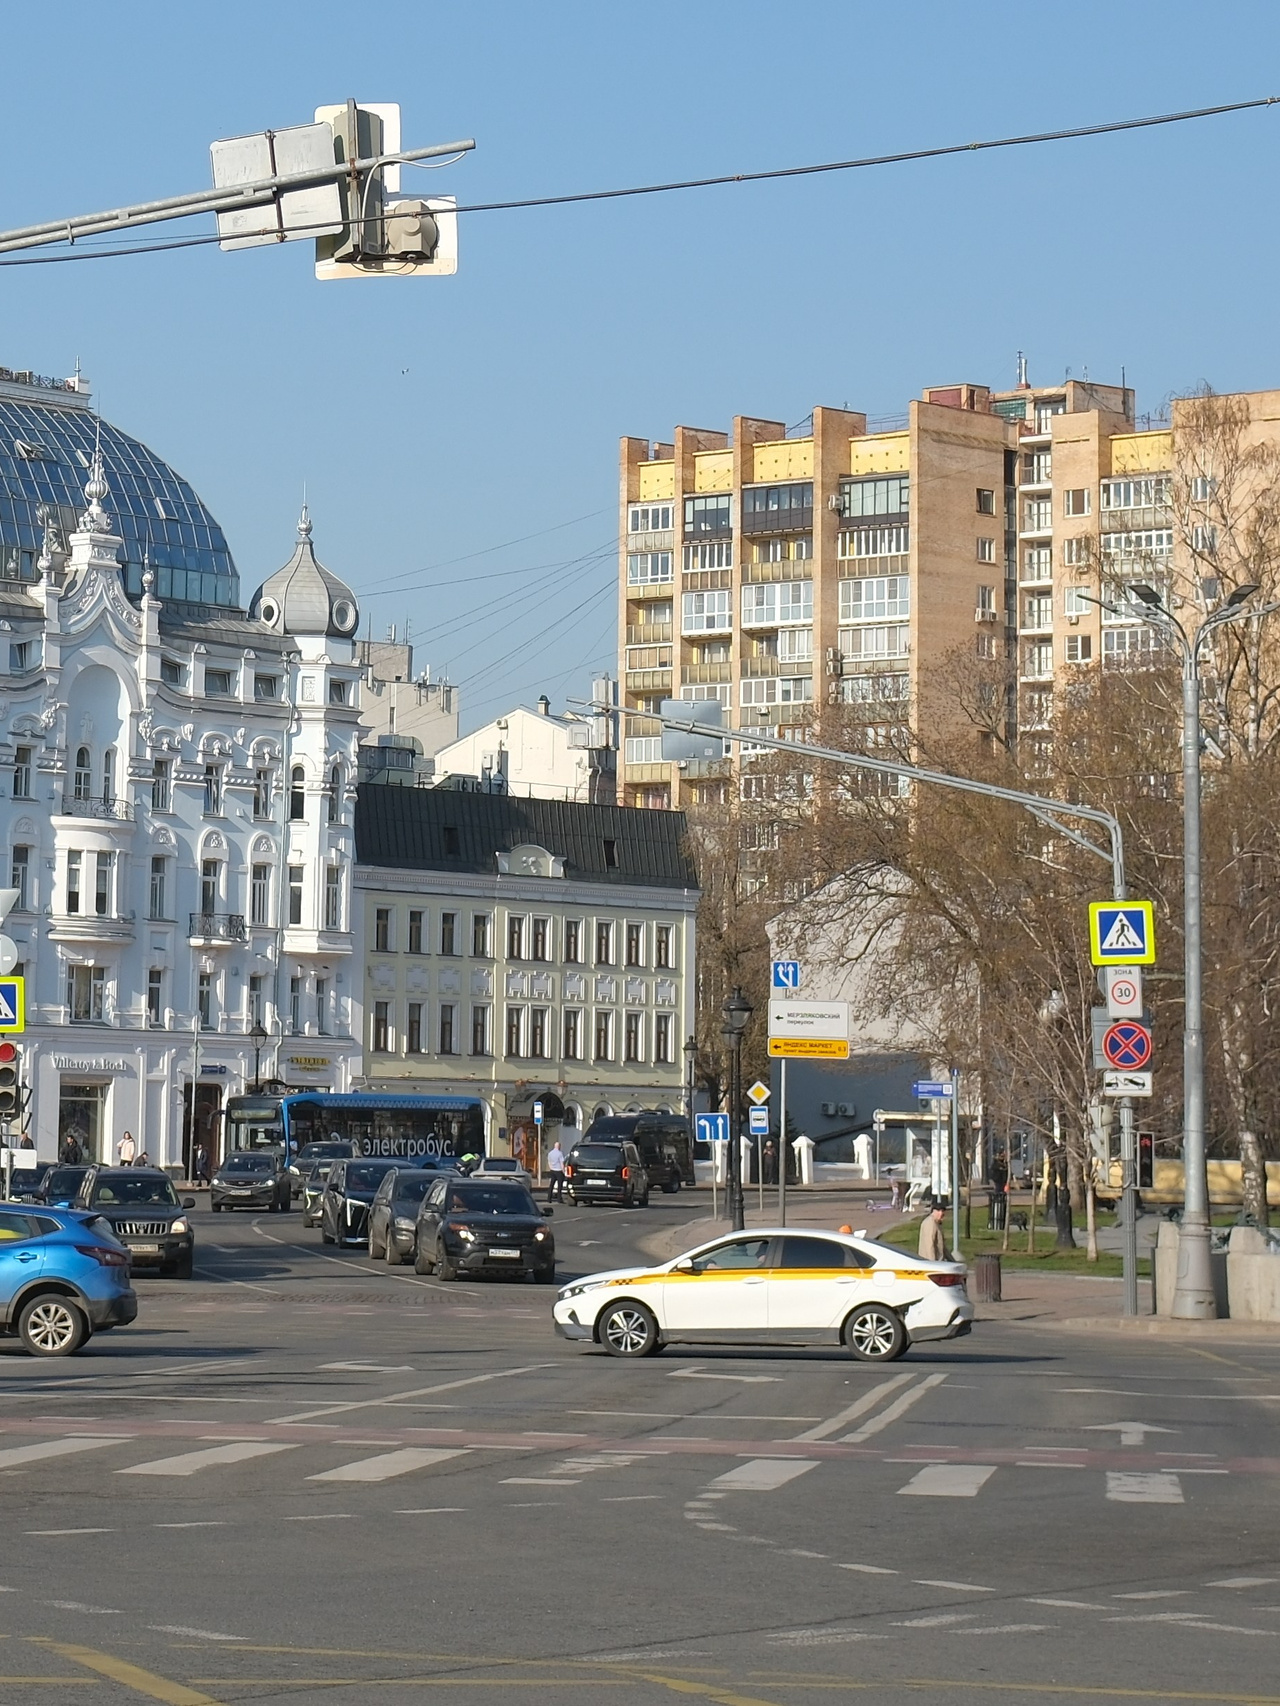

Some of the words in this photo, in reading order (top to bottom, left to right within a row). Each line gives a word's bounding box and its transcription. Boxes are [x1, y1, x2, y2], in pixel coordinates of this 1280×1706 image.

[1117, 988, 1131, 997] 30
[50, 1051, 90, 1072] Villeroy
[101, 1058, 127, 1071] Boch
[363, 1132, 455, 1161] электробус.
